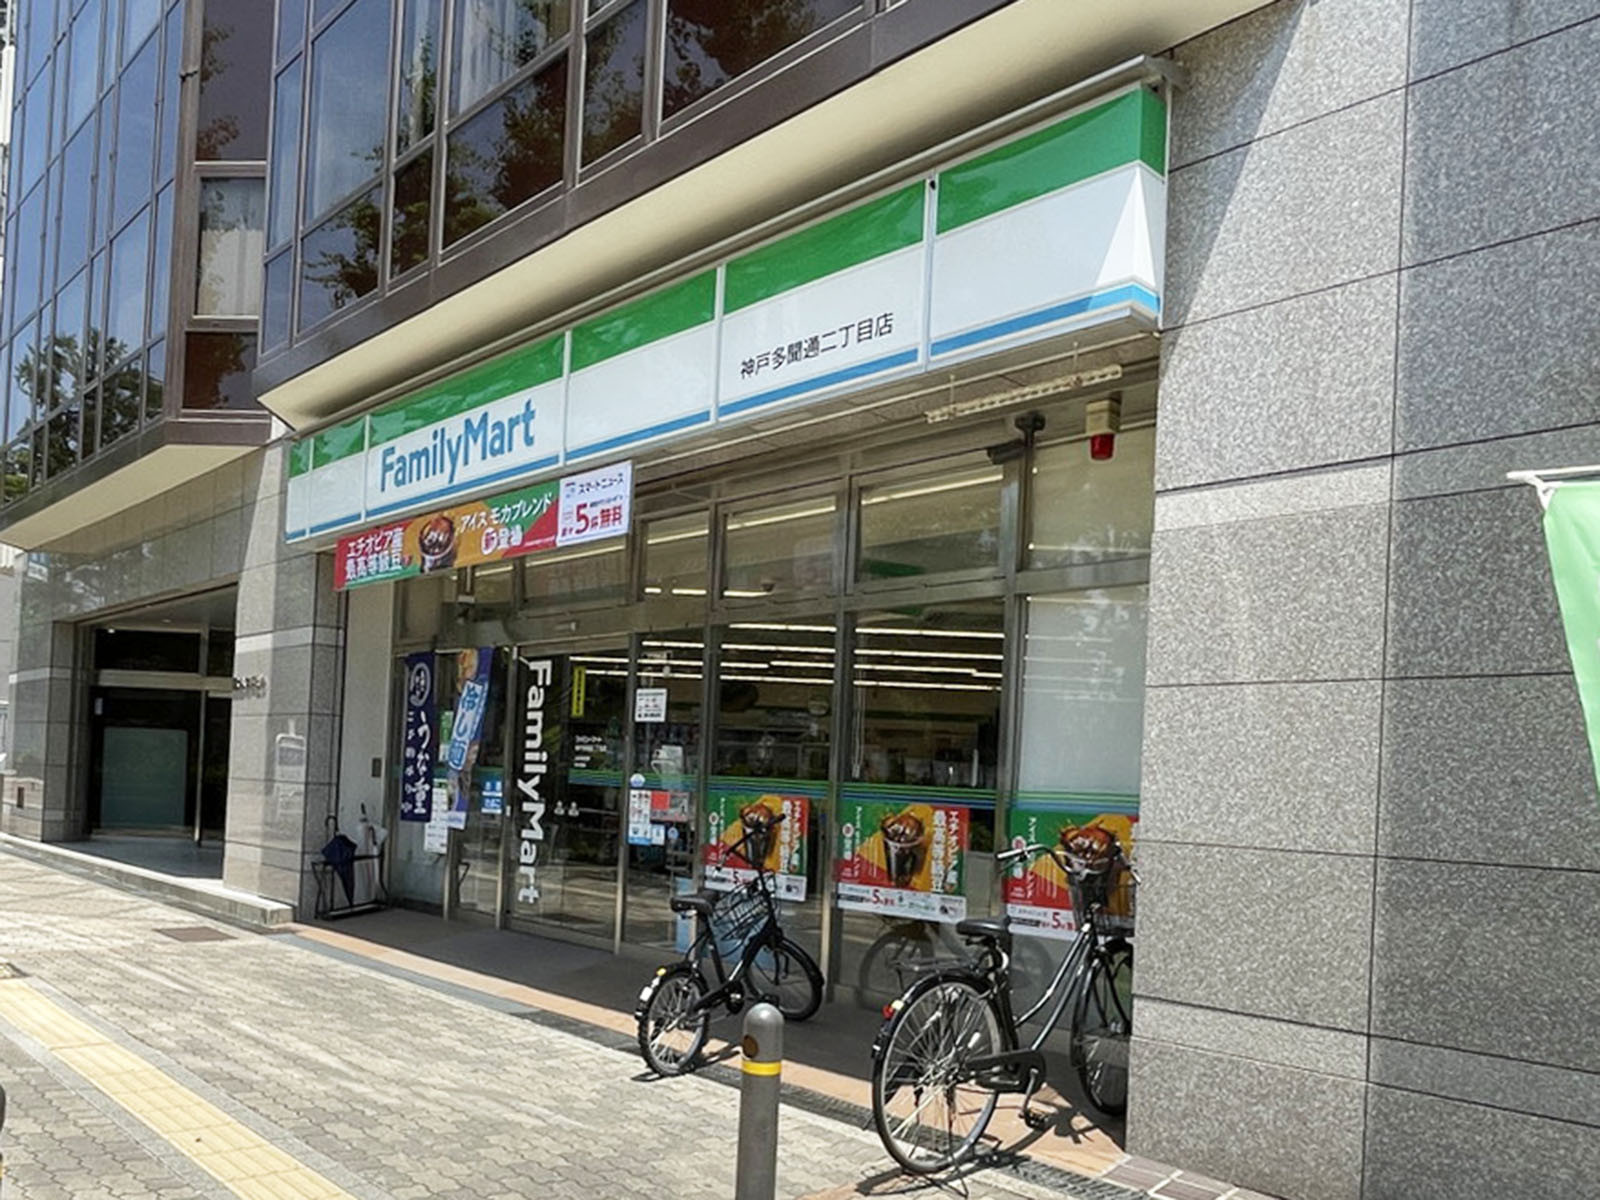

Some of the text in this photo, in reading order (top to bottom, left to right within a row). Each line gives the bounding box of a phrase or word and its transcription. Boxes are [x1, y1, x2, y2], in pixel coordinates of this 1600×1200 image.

[741, 313, 893, 379] 神戸多聞通二丁目店
[381, 398, 536, 492] FamilyMart
[347, 527, 404, 558] エチオピア産
[461, 492, 553, 534] アイス モカブレンド
[416, 711, 431, 814] うな重
[517, 660, 552, 904] FamilyMart
